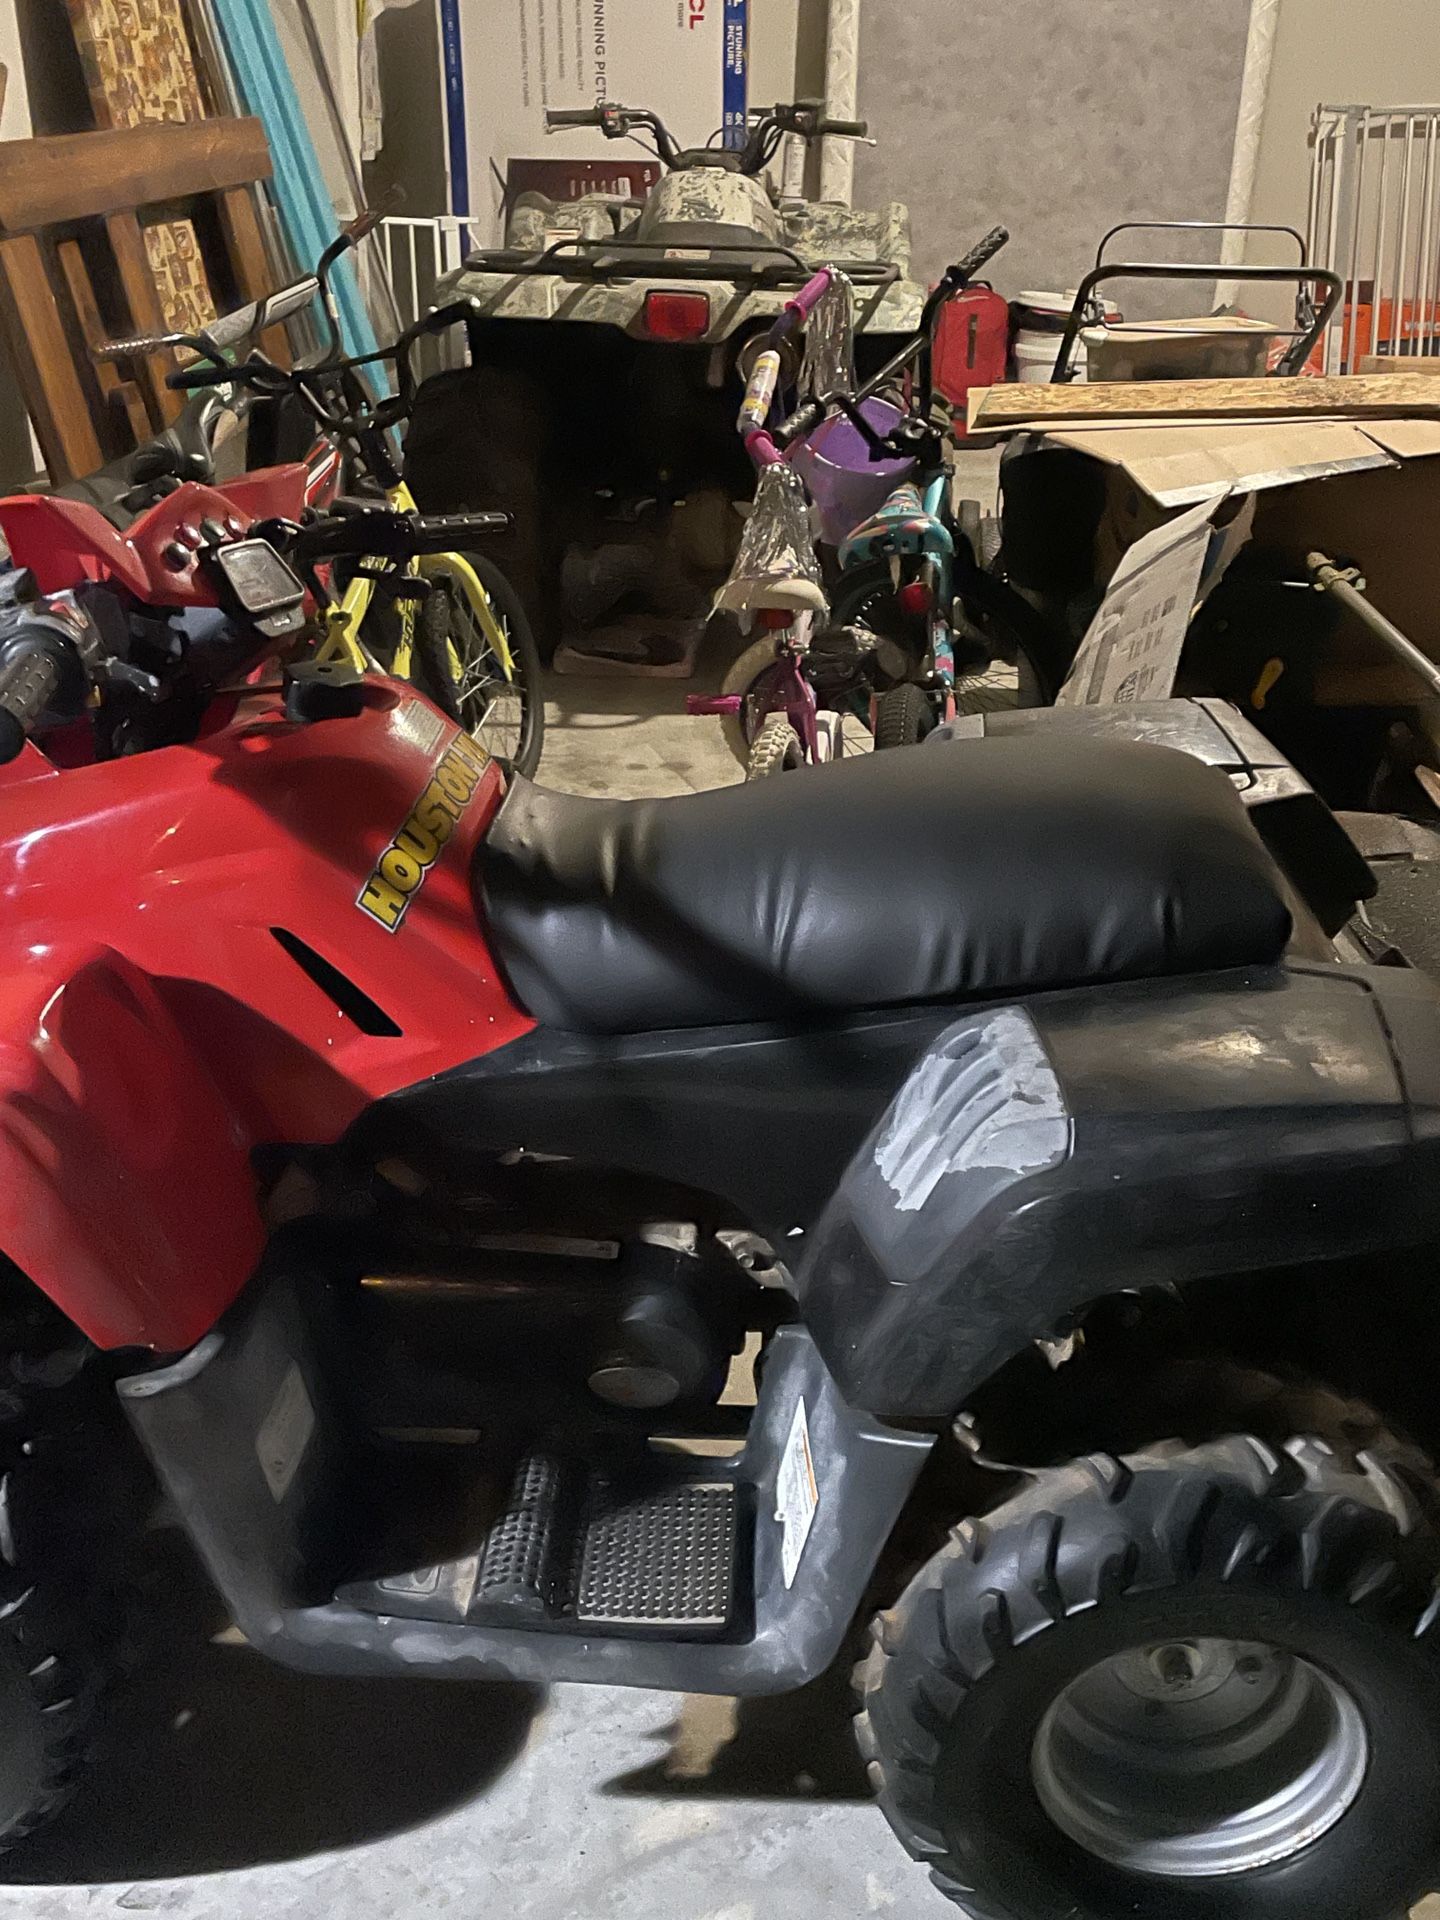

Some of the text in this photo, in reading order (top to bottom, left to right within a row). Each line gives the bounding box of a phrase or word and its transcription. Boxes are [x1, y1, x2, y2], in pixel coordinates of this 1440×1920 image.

[593, 0, 607, 104] NNING PICTU
[735, 25, 743, 75] STUNNING
